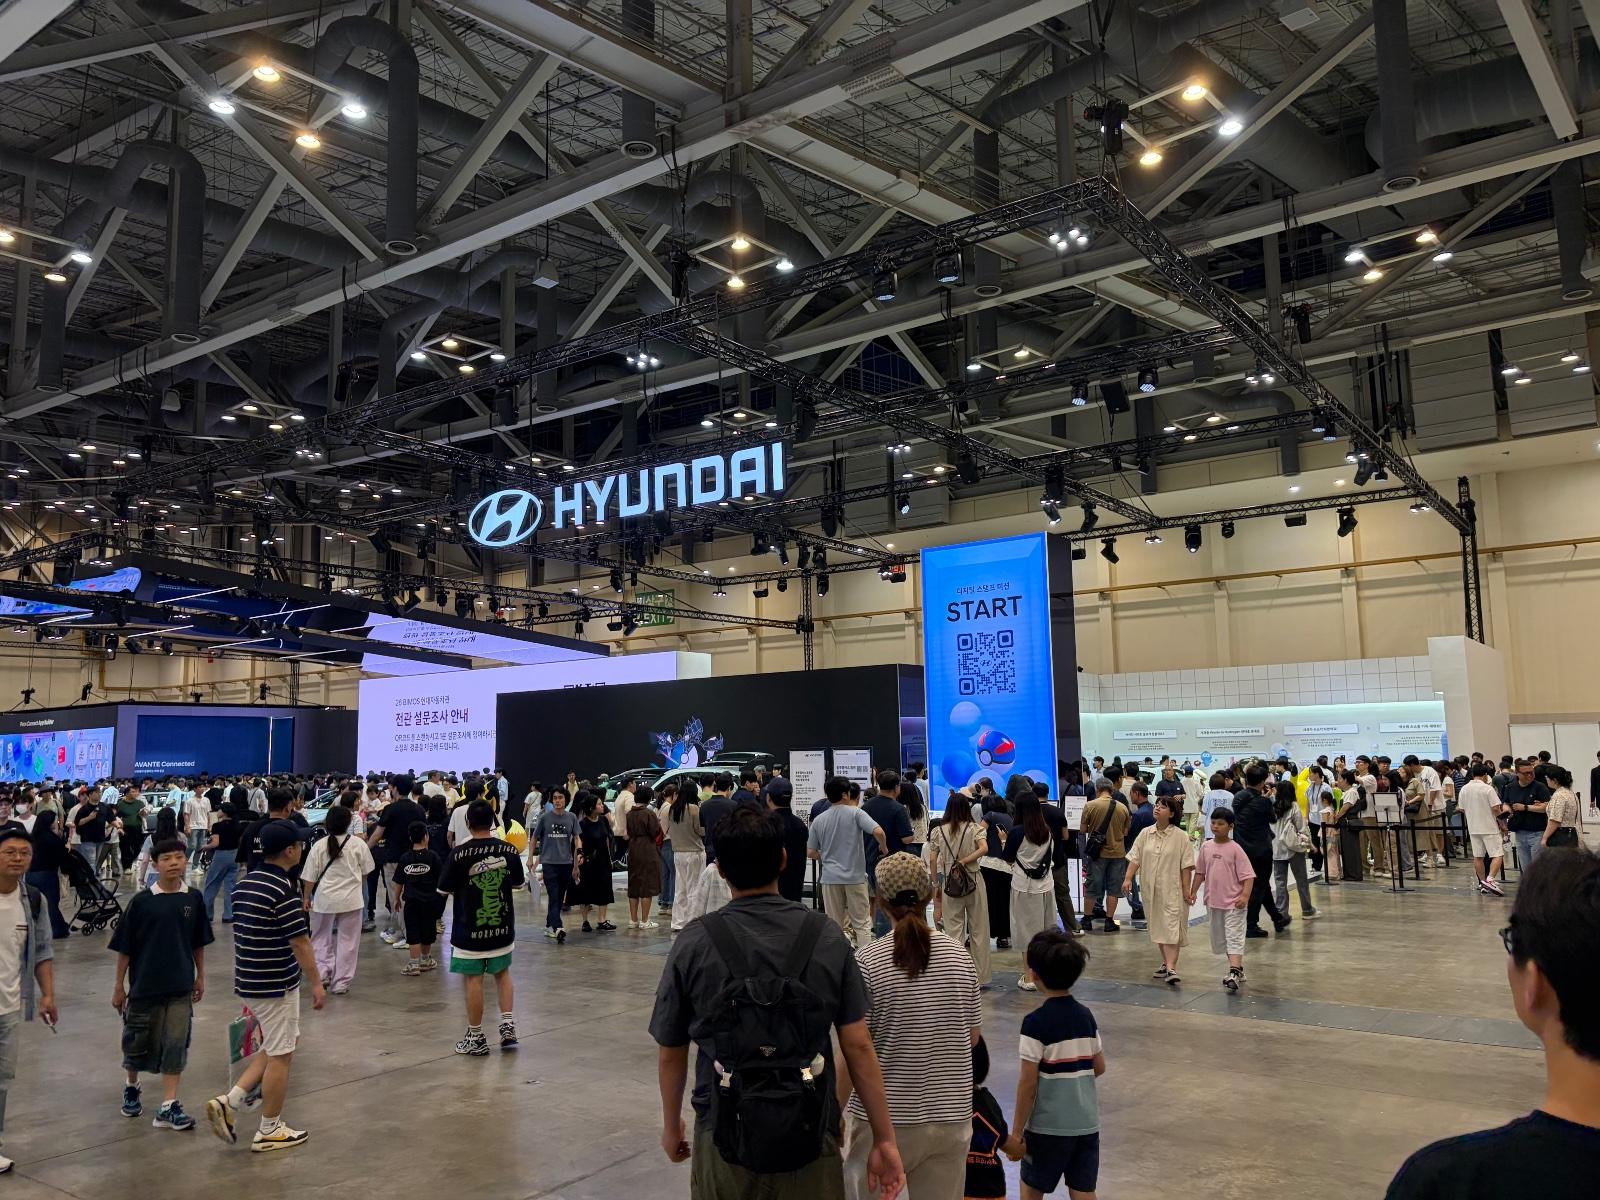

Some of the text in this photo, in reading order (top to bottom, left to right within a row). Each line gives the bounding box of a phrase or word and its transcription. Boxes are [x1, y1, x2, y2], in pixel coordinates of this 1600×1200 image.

[554, 442, 784, 528] HYUNDAI
[956, 585, 975, 595] 디지털
[976, 584, 996, 593] 스탬프
[946, 595, 1023, 623] START
[395, 707, 469, 727] 전관 설문조사 안내
[161, 760, 195, 768] Connected
[498, 845, 518, 855] TIGER
